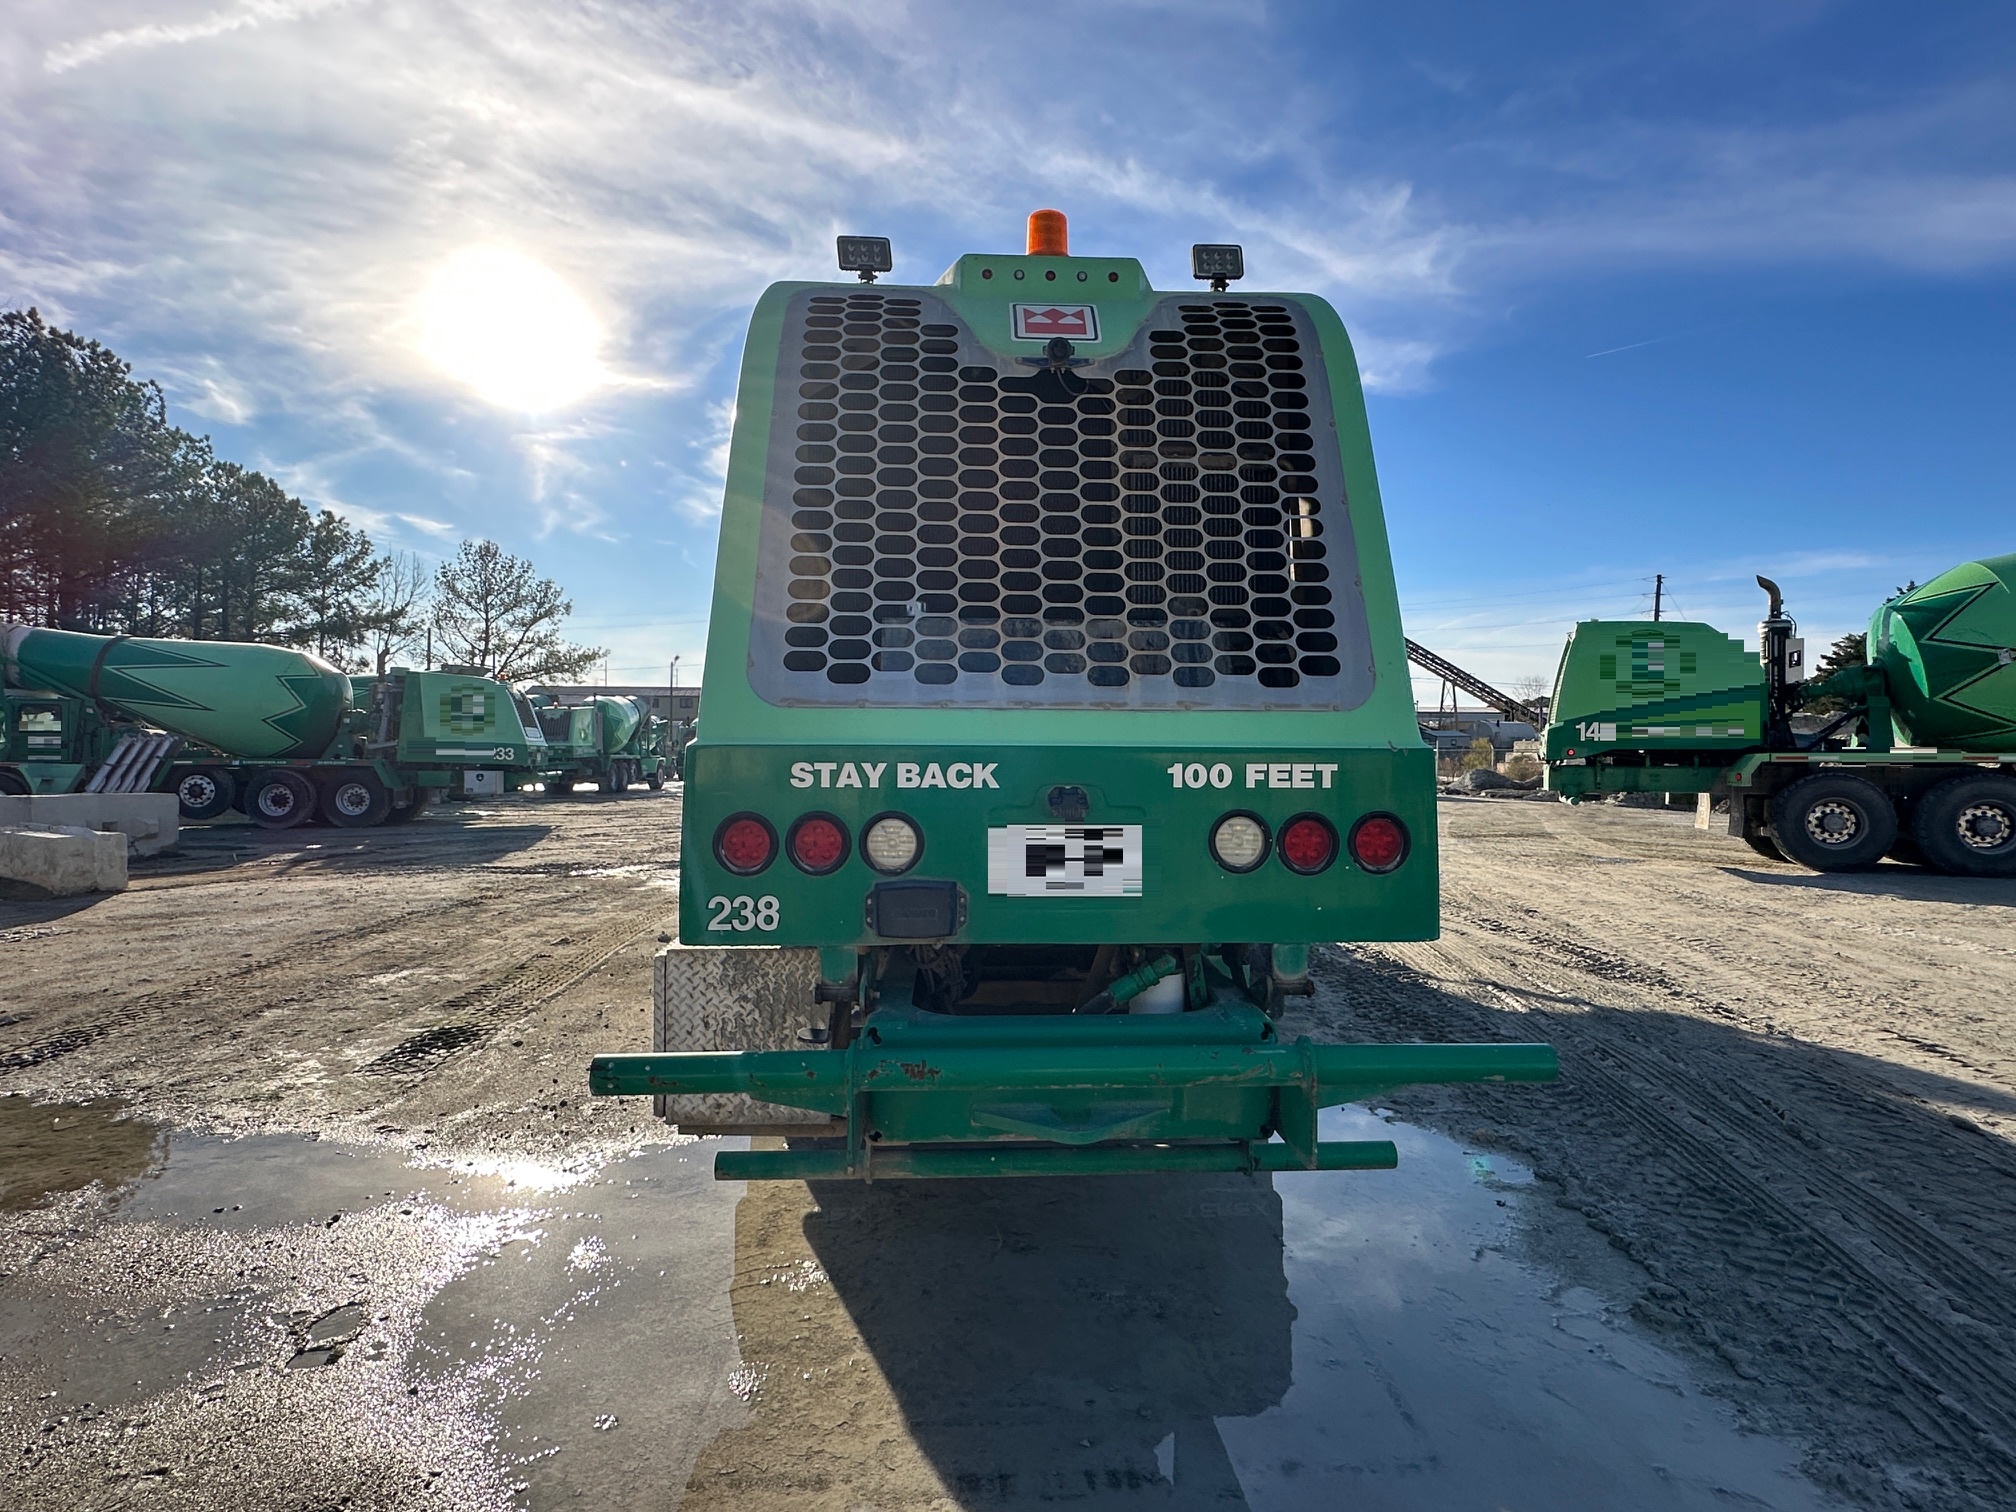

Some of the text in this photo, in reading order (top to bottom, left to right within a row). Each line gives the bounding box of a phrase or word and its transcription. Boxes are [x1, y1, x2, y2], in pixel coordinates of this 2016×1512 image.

[1575, 722, 1604, 742] 14
[494, 747, 515, 760] 33
[789, 762, 1338, 789] STAY BACK 100 FEET
[707, 895, 780, 931] 238
